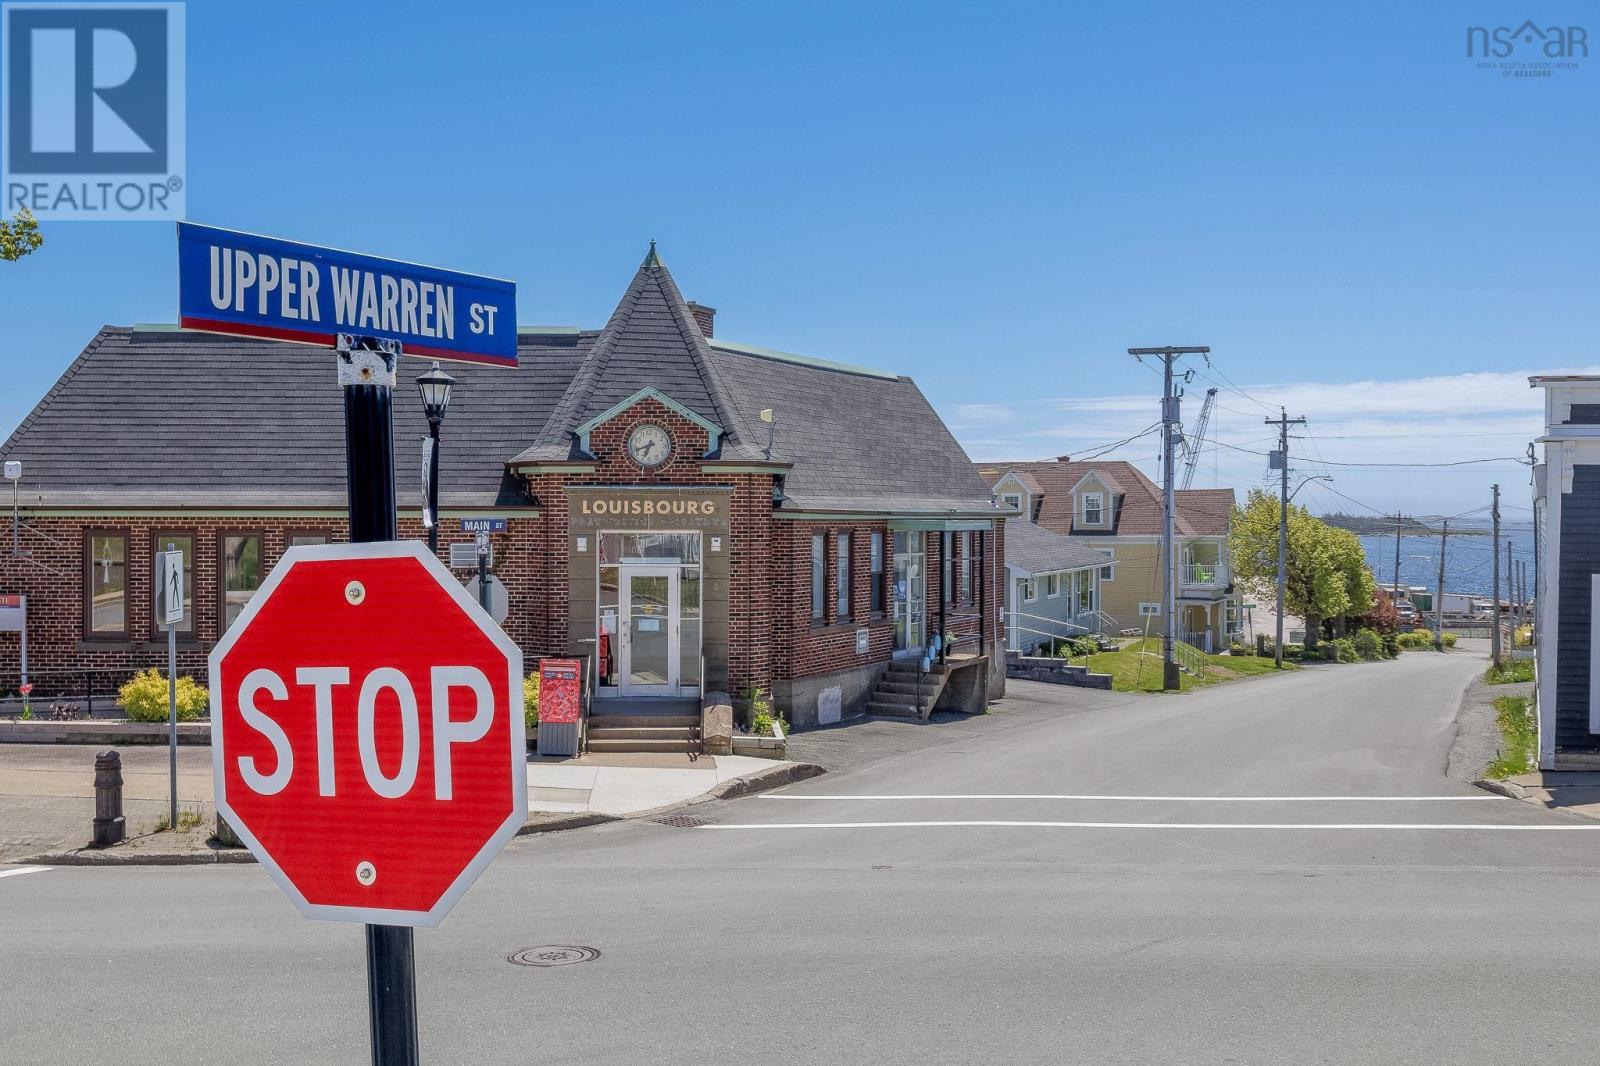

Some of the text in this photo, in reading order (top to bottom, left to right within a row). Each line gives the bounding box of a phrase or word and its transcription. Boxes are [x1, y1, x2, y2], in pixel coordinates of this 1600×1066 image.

[210, 245, 498, 340] UPPER WARREN ST
[464, 521, 490, 531] MAIN
[582, 500, 715, 515] LOUISBOURG
[237, 665, 495, 801] STOP
